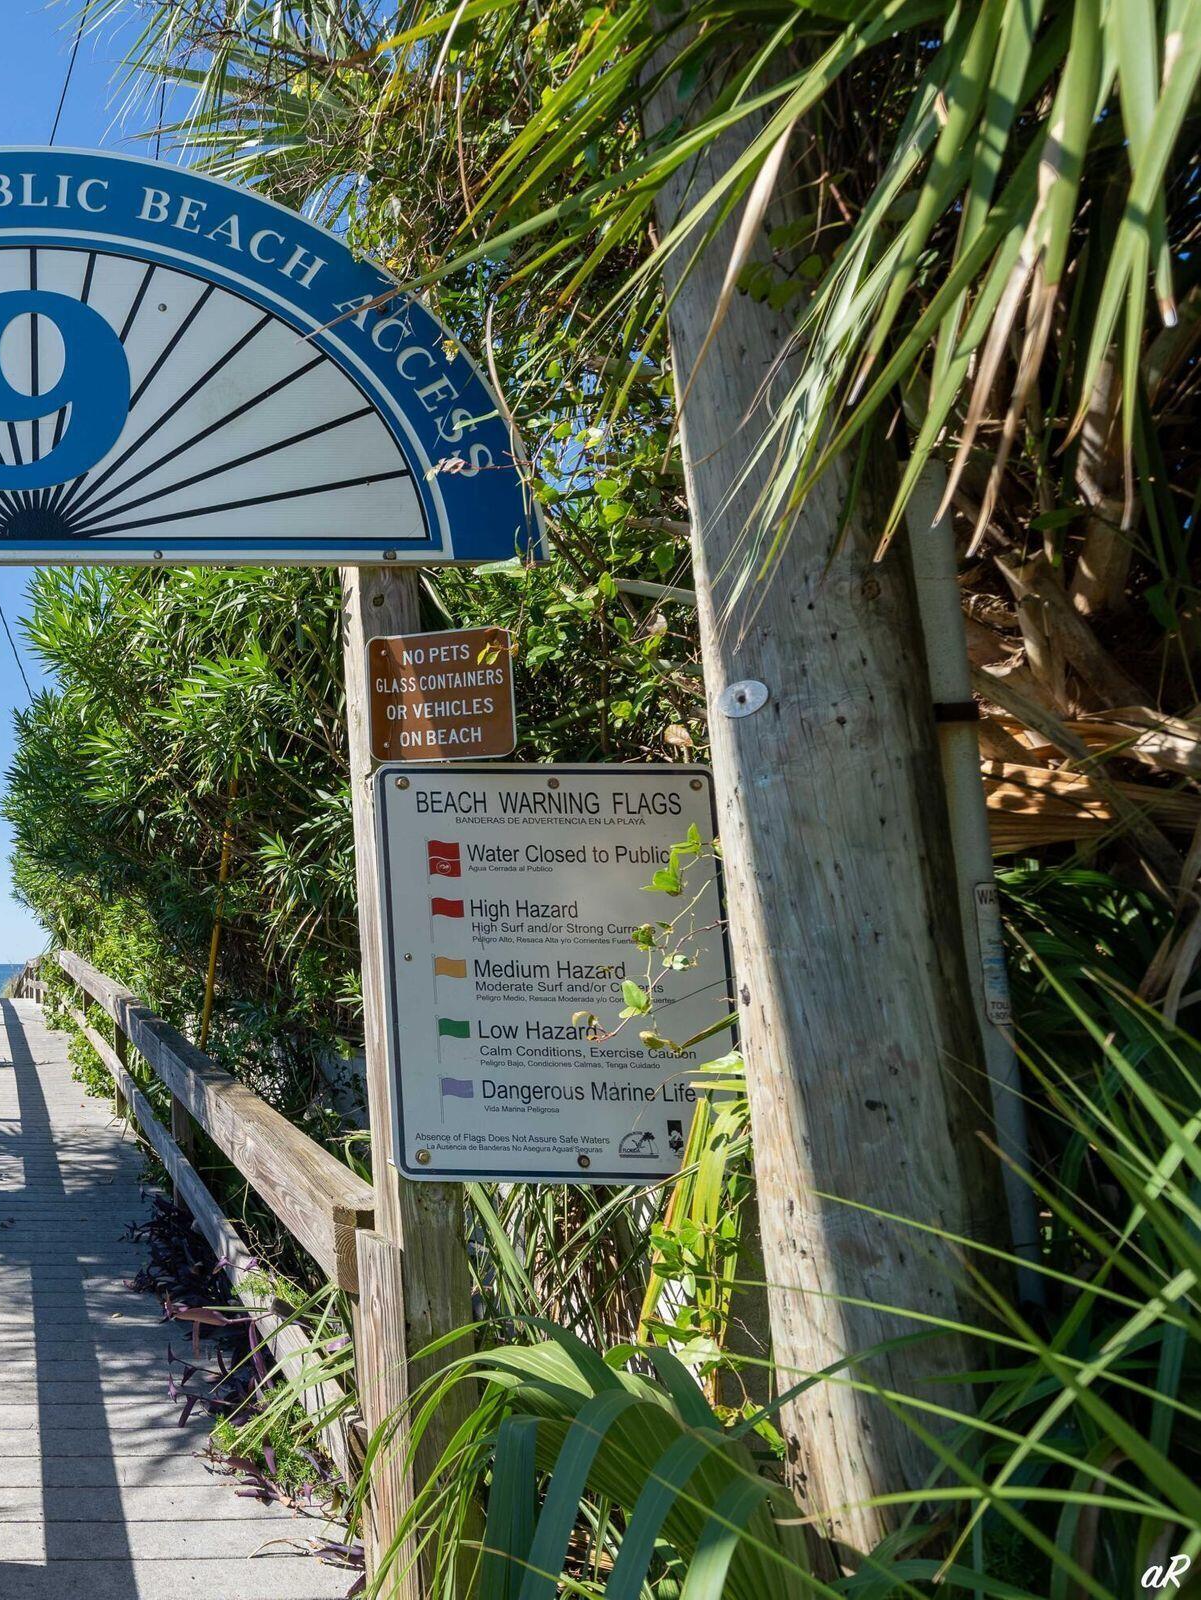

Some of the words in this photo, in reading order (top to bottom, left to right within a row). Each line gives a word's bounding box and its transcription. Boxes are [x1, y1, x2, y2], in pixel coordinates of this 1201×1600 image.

[136, 186, 329, 291] BEACH
[332, 294, 495, 477] ACCESS
[402, 648, 425, 666] NO
[429, 644, 470, 663] PETS
[376, 677, 416, 693] GLASS
[420, 668, 503, 691] CONTAINERS
[386, 704, 407, 720] OR
[413, 698, 494, 719] VEHICLES
[400, 731, 422, 747] ON
[426, 726, 482, 746] BEACH
[416, 791, 487, 813] BEACH
[499, 791, 600, 815] WARNING
[612, 792, 682, 815] FLAGS
[455, 817, 505, 825] BANDERAS
[507, 817, 520, 825] DE
[522, 817, 587, 825] ADVERTENCIA
[589, 817, 601, 825] EN
[617, 818, 646, 826] PLAYA
[467, 844, 519, 862] Water
[525, 844, 586, 863] Closed
[592, 846, 609, 863] to
[615, 845, 670, 864] Public
[468, 865, 487, 873] Agua
[470, 899, 510, 922] High
[516, 899, 578, 919] Hazard
[471, 922, 498, 934] High
[501, 922, 524, 933] Surf
[527, 923, 563, 933] and/or
[566, 923, 604, 936] Strong
[474, 960, 550, 979] Medium
[557, 960, 626, 980] Hazard
[475, 981, 534, 992] Moderate
[537, 981, 563, 992] Surf
[566, 982, 607, 993] and/or
[478, 1020, 519, 1039] Low
[479, 1045, 513, 1056] Calm
[516, 1045, 586, 1059] Conditions,
[590, 1047, 644, 1059] Exercise
[480, 1060, 506, 1068] Peligro
[606, 1061, 628, 1070] Tenga
[629, 1061, 661, 1069] Cuidado
[482, 1079, 585, 1105] Dangerous
[591, 1081, 656, 1102] Marine
[662, 1083, 696, 1102] Life
[484, 1105, 500, 1113] Vida
[527, 1106, 560, 1115] Peligrosa
[415, 1132, 451, 1141] Absence
[452, 1133, 461, 1141] of
[463, 1133, 486, 1144] Flags
[488, 1134, 510, 1142] Does
[511, 1134, 527, 1143] Not
[528, 1135, 557, 1144] Assure
[559, 1136, 579, 1144] Safe
[580, 1136, 611, 1145] Waters
[436, 1143, 467, 1151] Ausencia
[478, 1144, 511, 1152] Banderas
[552, 1145, 574, 1154] Aguas
